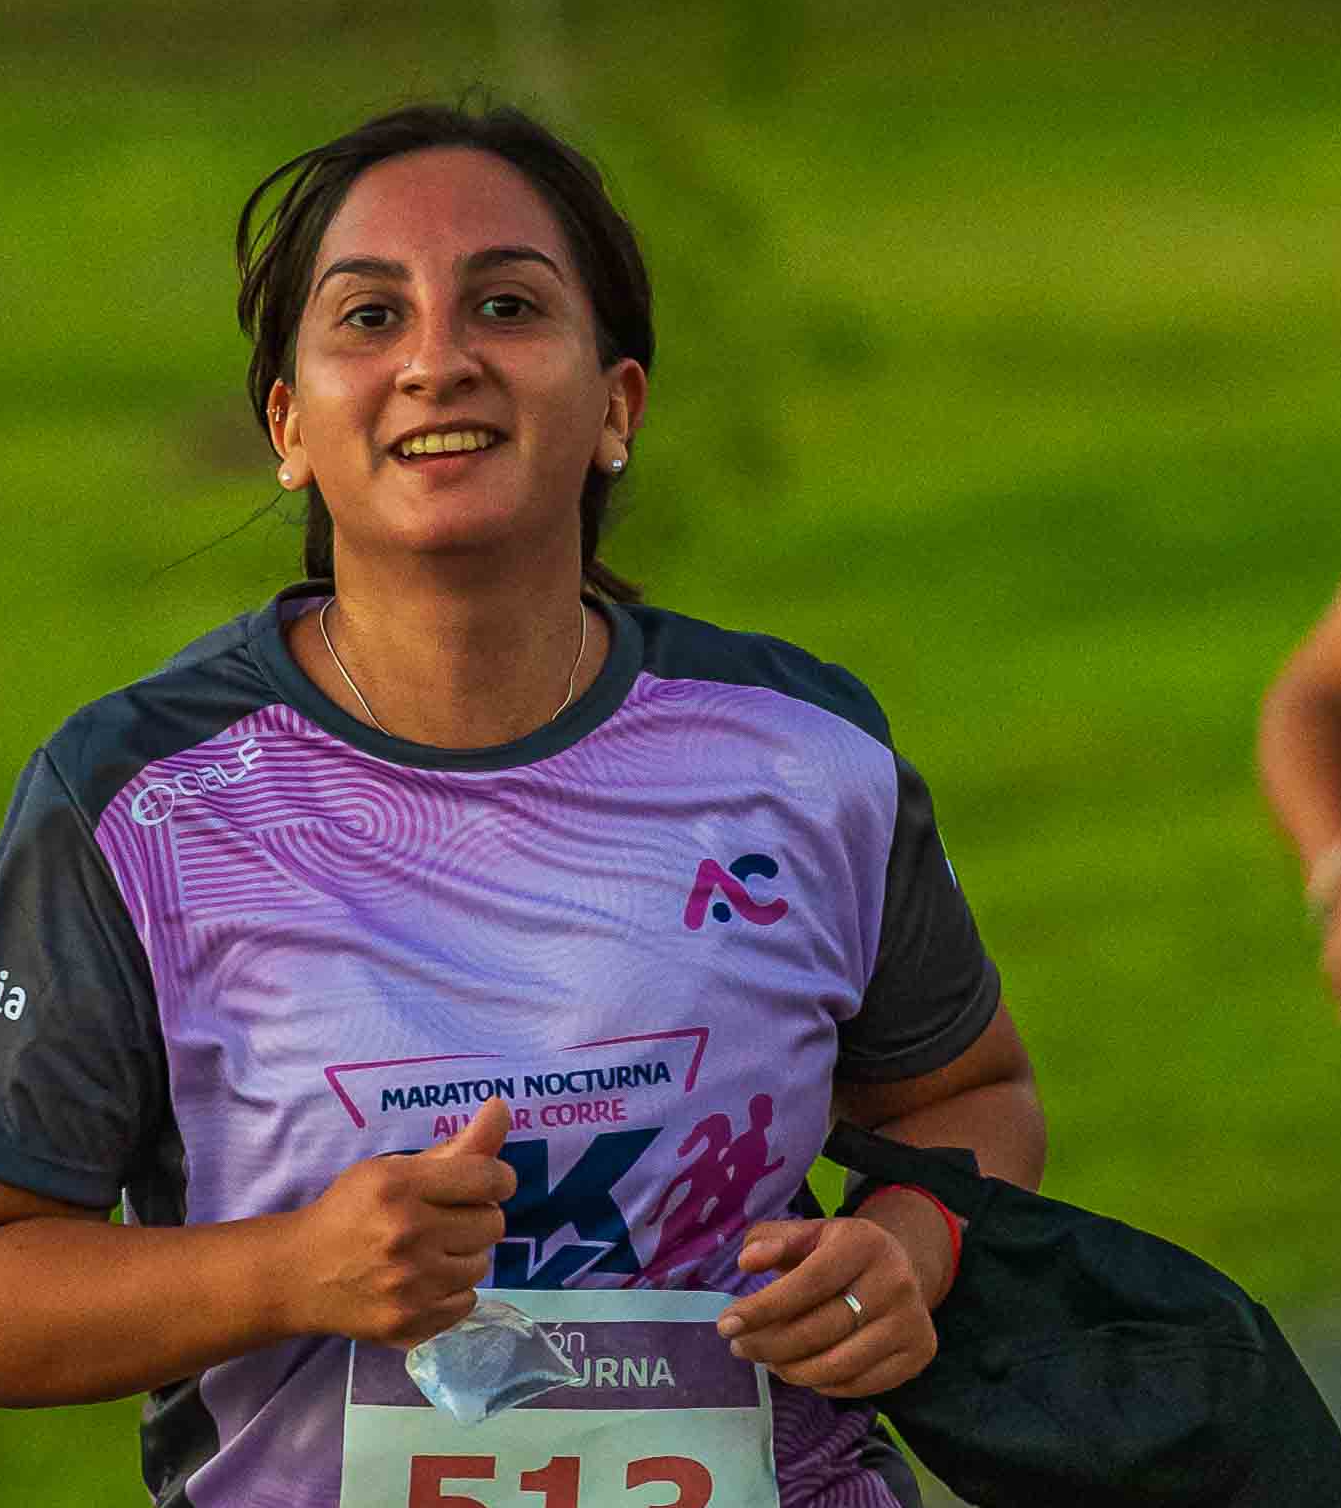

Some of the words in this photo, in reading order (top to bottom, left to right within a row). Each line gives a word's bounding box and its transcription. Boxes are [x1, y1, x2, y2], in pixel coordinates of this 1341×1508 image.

[381, 1077, 514, 1111] MARATON
[524, 1061, 671, 1097] NOCTURNA
[540, 1099, 628, 1127] CORRE
